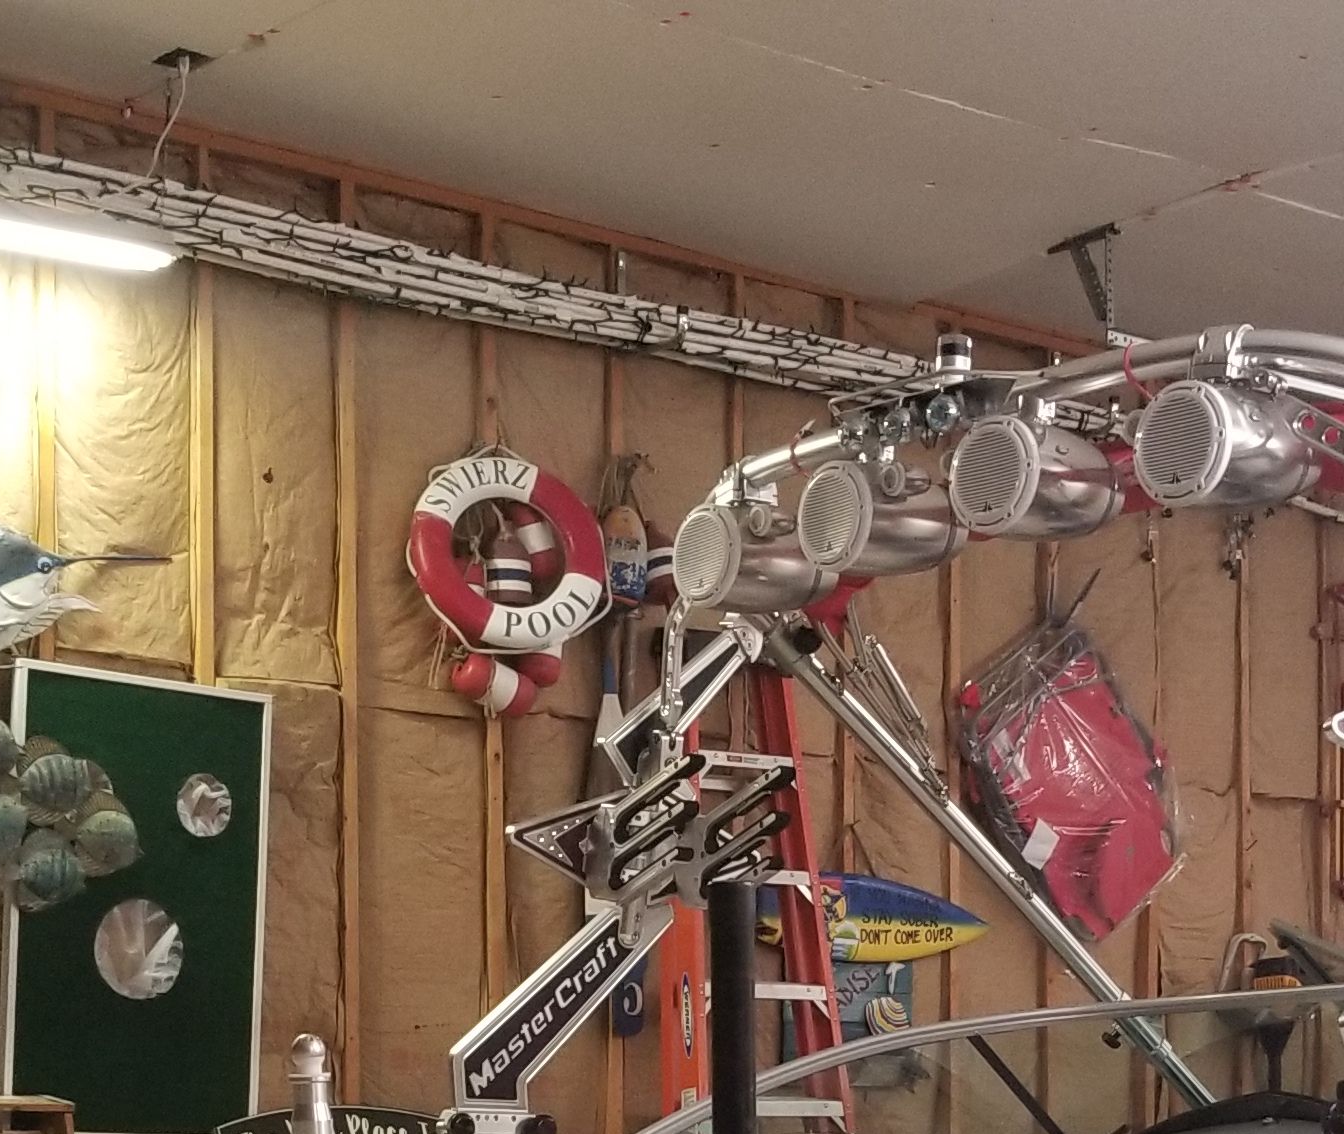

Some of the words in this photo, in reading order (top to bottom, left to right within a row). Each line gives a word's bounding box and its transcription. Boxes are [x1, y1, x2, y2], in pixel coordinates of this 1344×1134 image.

[424, 459, 531, 513] SWIERZ
[504, 587, 596, 639] POOL
[893, 928, 922, 945] COME
[924, 926, 955, 944] OVER
[467, 935, 619, 1098] MasterCraft
